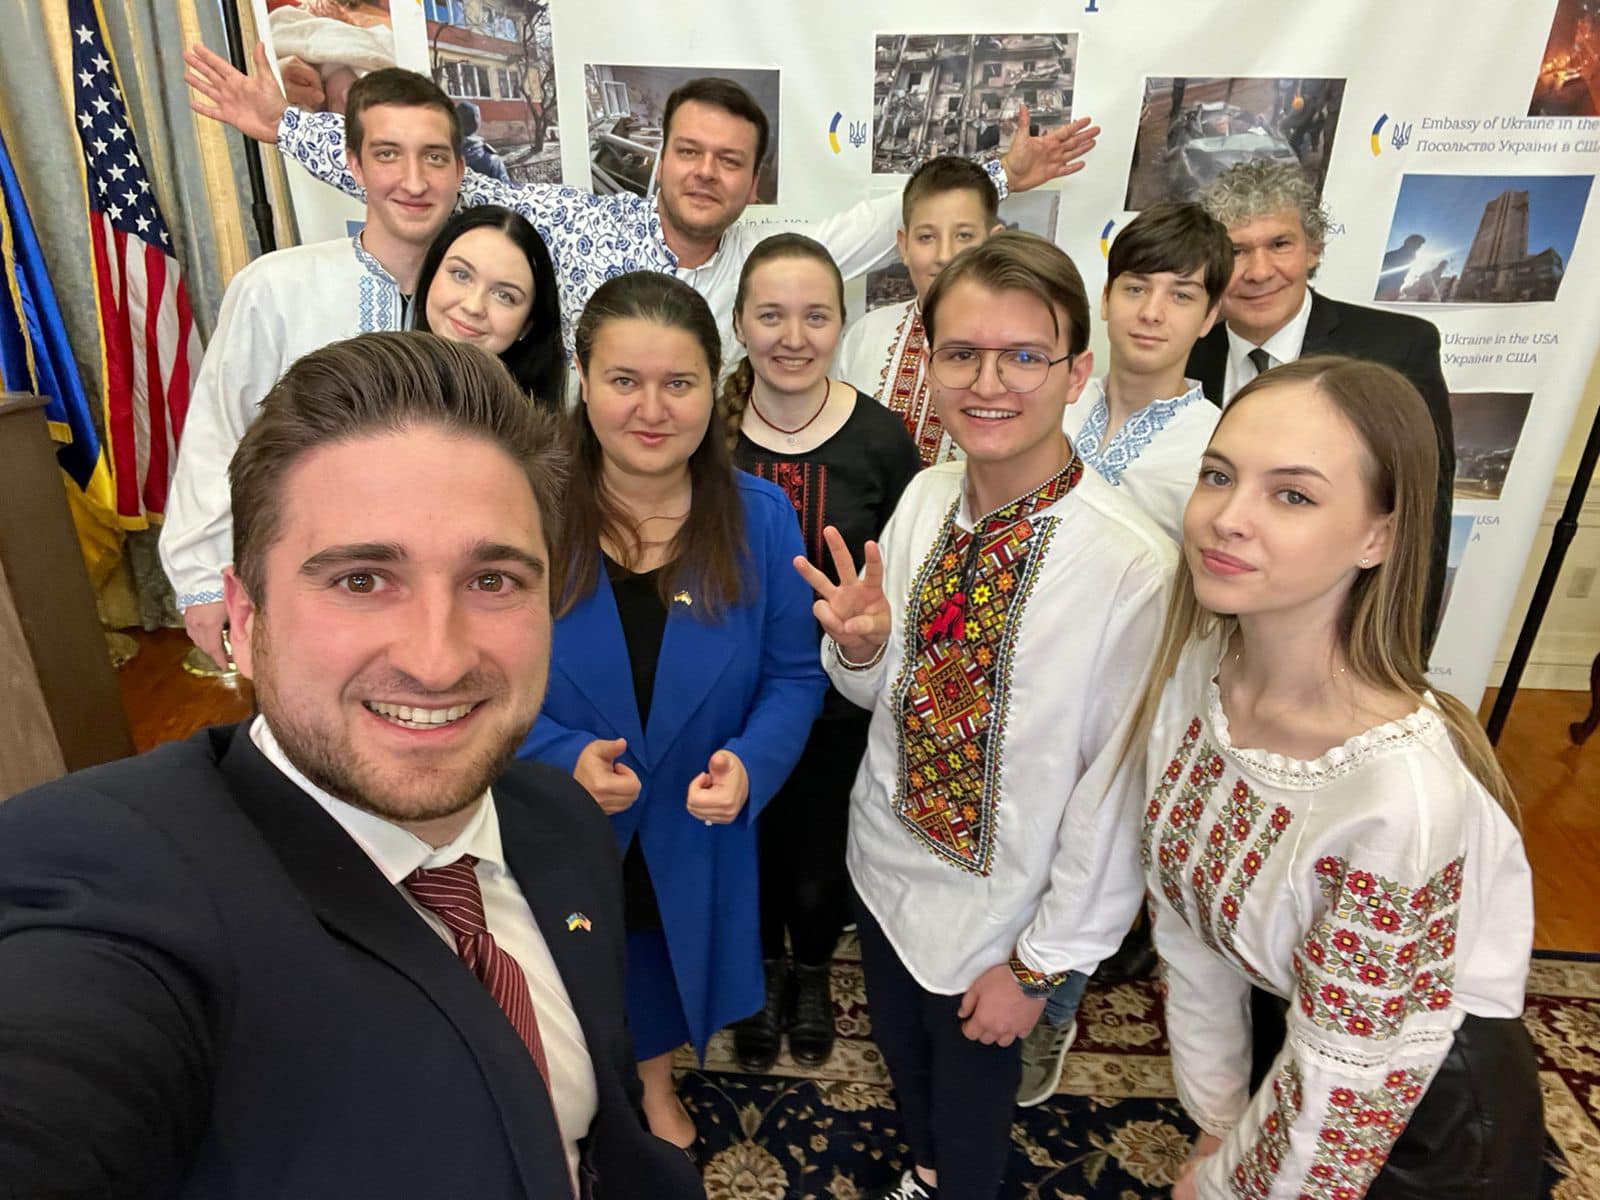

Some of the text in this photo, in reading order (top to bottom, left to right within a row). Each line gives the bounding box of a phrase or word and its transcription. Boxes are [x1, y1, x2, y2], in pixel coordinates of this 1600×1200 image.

[1421, 116, 1600, 134] Embassy of Ukraine in the
[1416, 140, 1496, 152] Посольство
[1562, 142, 1571, 152] в
[1575, 140, 1600, 153] СШ
[1444, 333, 1559, 345] Ukraine in the USA
[1506, 352, 1537, 363] США
[1476, 515, 1500, 526] USA
